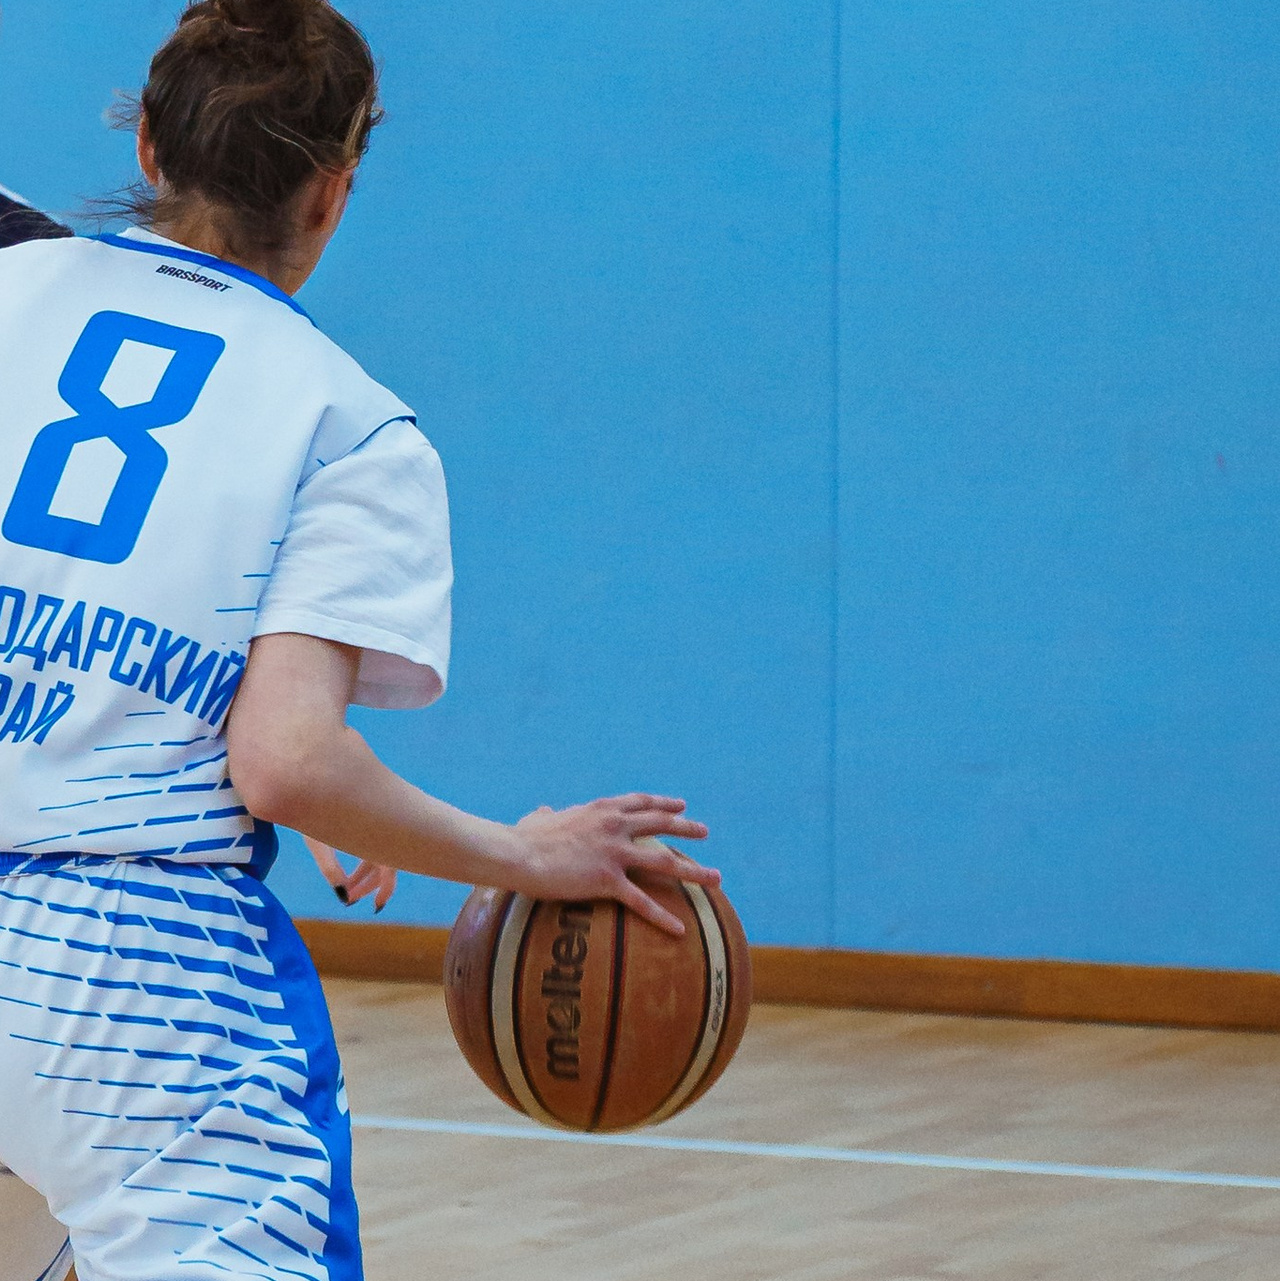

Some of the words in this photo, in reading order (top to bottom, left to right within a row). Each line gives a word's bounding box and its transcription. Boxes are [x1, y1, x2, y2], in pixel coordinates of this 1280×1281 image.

[155, 264, 233, 292] BARSSPORT
[2, 310, 226, 564] 8
[542, 902, 594, 1080] molten
